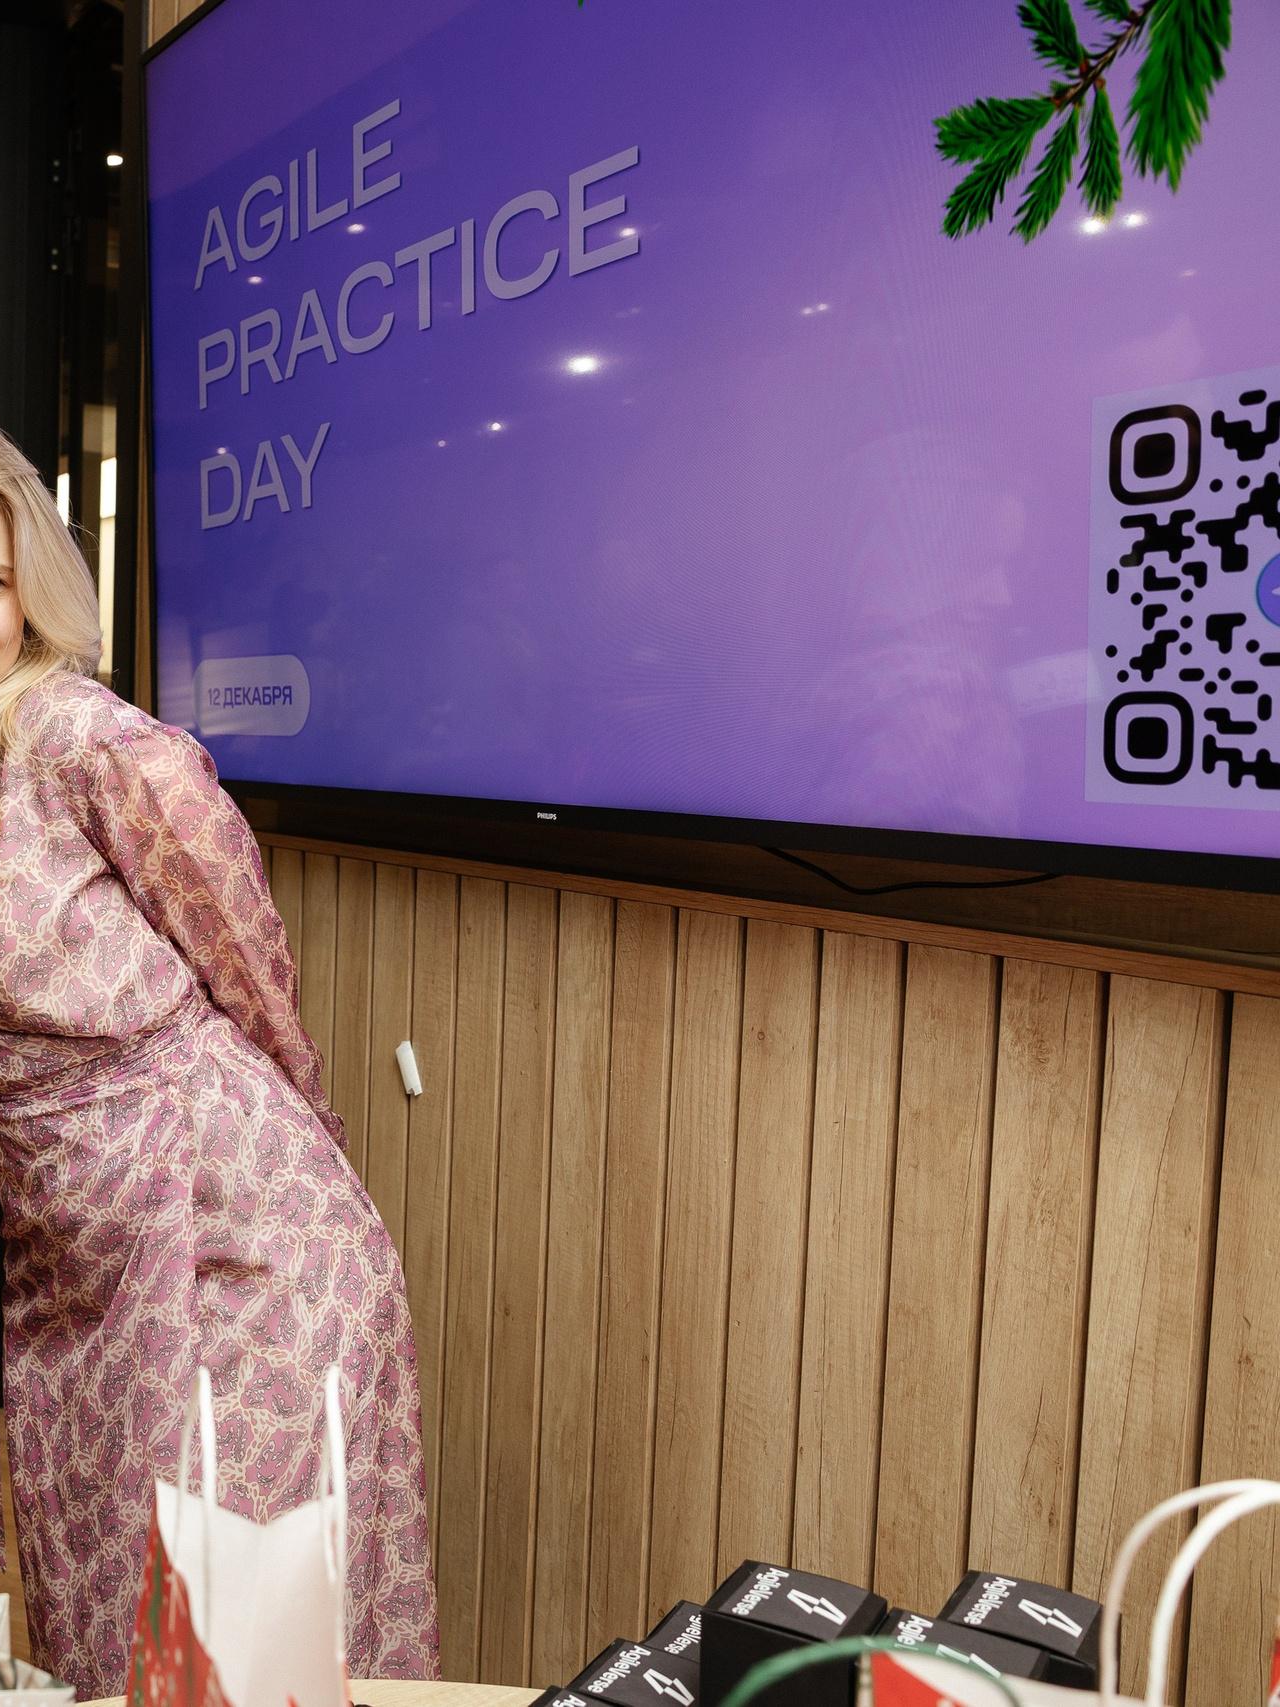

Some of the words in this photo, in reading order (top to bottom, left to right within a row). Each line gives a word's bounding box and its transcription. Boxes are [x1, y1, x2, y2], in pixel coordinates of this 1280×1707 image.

[194, 98, 401, 290] AGILE
[198, 146, 640, 410] PRACTICE
[200, 423, 331, 531] DAY
[208, 688, 221, 706] 12
[223, 685, 293, 709] ДЕКАБРЯ
[732, 1567, 789, 1616] AgileVerse
[963, 1576, 1017, 1625] AgileVerse
[664, 1614, 702, 1655] gileVerse
[894, 1614, 933, 1650] Agile
[587, 1645, 652, 1694] AgileVerse
